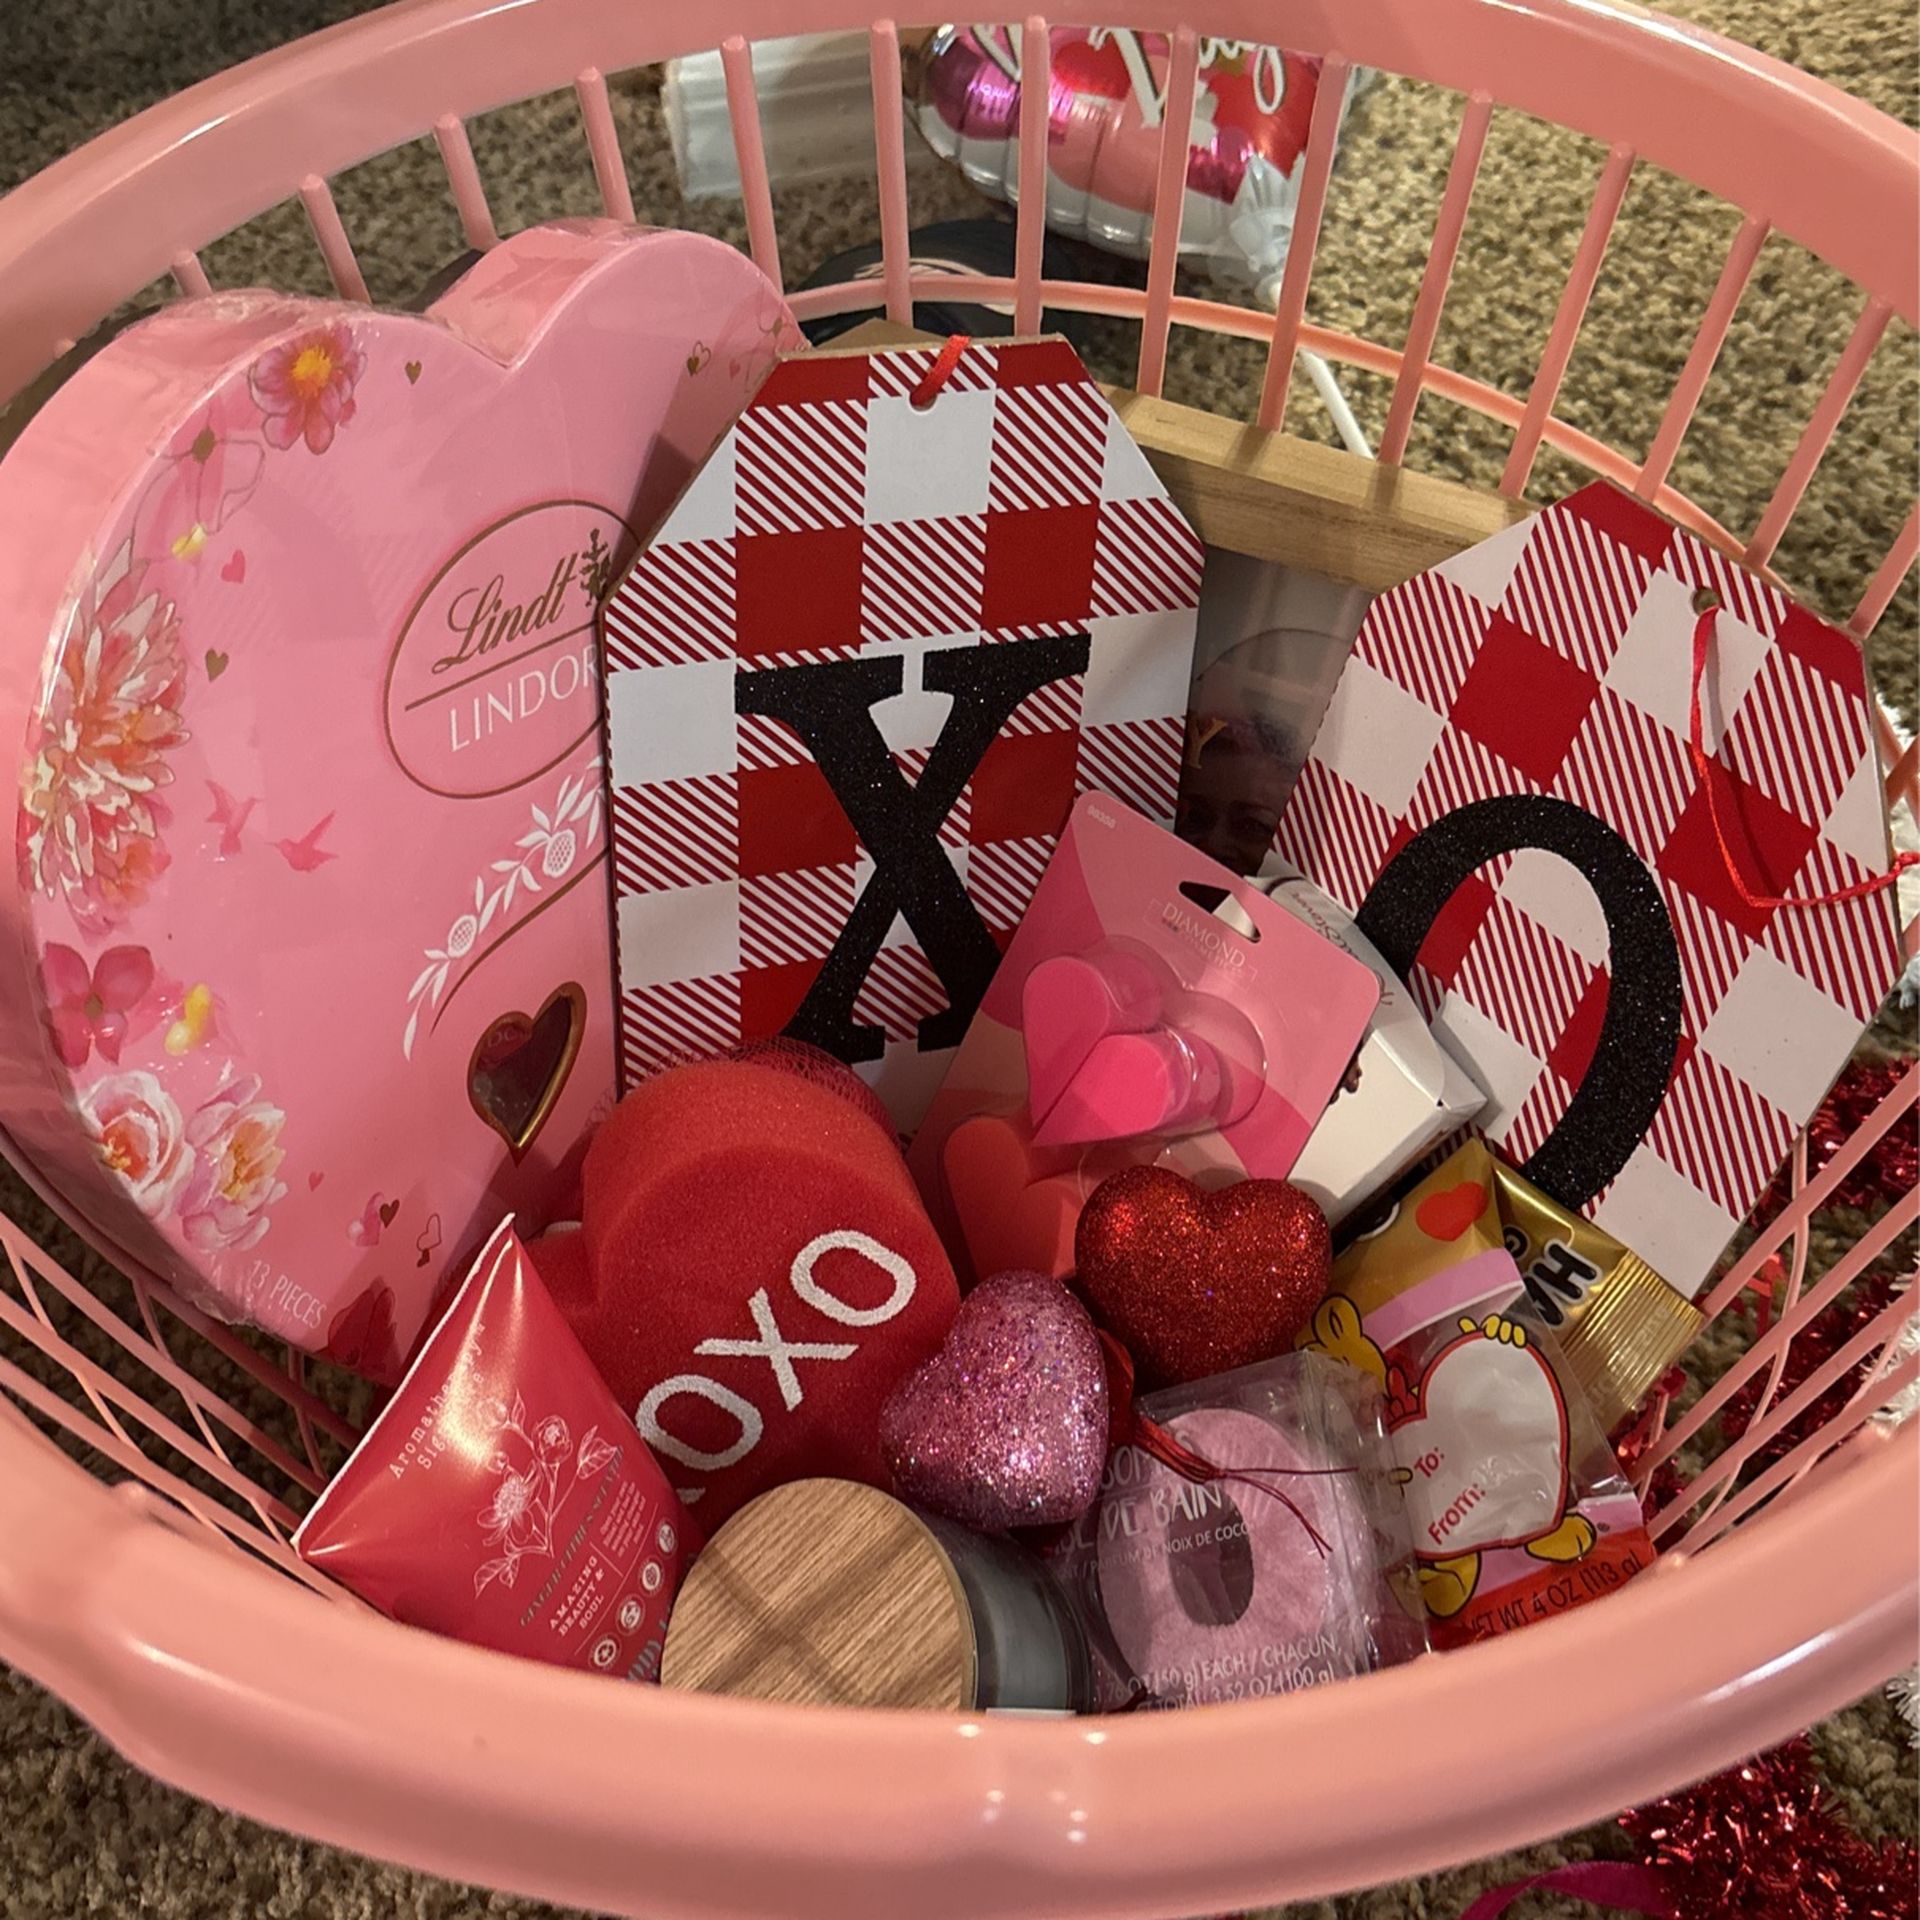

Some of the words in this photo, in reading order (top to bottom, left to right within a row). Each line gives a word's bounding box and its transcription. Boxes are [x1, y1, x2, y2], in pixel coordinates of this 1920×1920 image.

[432, 552, 577, 675] Lindt
[450, 644, 599, 752] LINDOR
[735, 632, 1091, 1065] X
[1161, 902, 1247, 969] DIAMOND
[1357, 794, 1682, 1209] O
[249, 1259, 271, 1289] 13
[269, 1275, 328, 1330] PIECES
[635, 1229, 917, 1504] OXO
[389, 1338, 483, 1479] Aromathepy
[1414, 1446, 1445, 1479] To:
[1150, 1480, 1223, 1530] BAIN
[1165, 1535, 1194, 1555] NOIX
[1195, 1531, 1212, 1547] DE
[1214, 1523, 1250, 1542] COCO
[1427, 1482, 1486, 1545] From:
[549, 1555, 598, 1630] AMAZING
[559, 1583, 598, 1638] BEAUTY
[579, 1594, 605, 1630] SOUL
[1499, 1598, 1529, 1630] WT
[1532, 1591, 1547, 1614] 4
[1552, 1577, 1583, 1609] OZ
[1579, 1561, 1620, 1597] (113
[1202, 1654, 1245, 1682] EACH
[1211, 1682, 1244, 1702] 352
[1250, 1675, 1275, 1696] OZ
[1276, 1664, 1314, 1694] (100
